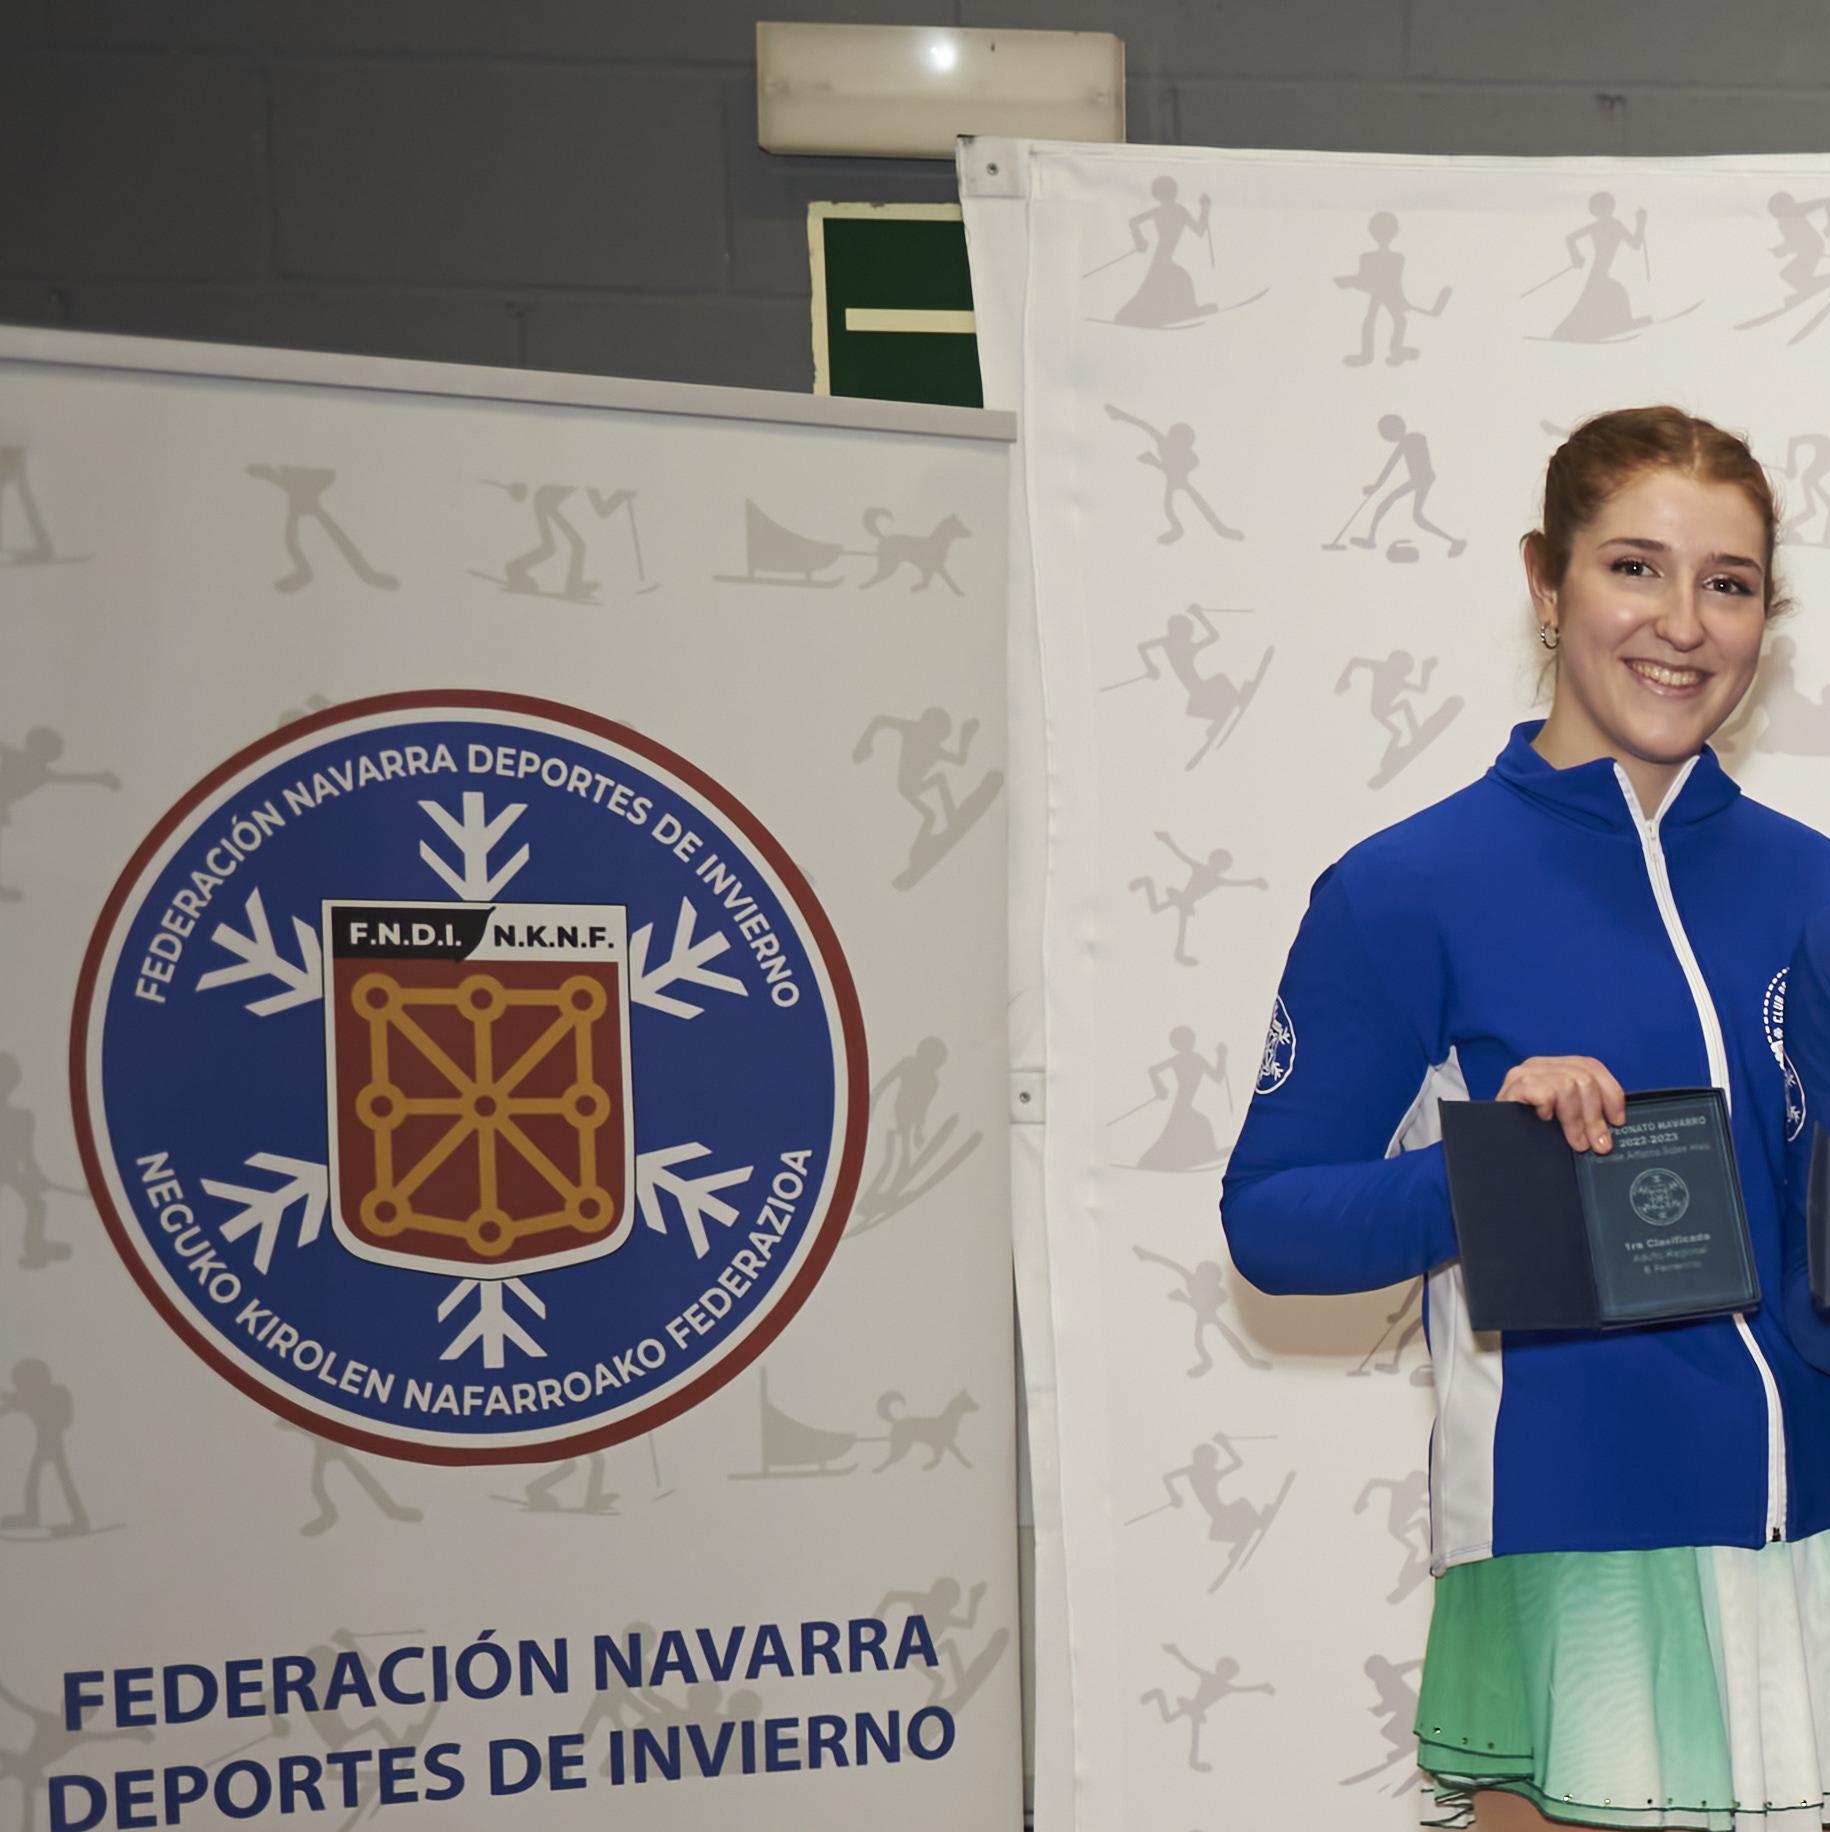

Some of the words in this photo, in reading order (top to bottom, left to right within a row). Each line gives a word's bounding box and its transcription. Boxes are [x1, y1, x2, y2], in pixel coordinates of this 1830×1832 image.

[134, 799, 286, 1005] FEDERACIÓN
[286, 742, 458, 819] NAVARRA
[466, 743, 653, 822] DEPORTES
[650, 809, 705, 866] DE
[695, 852, 802, 1009] INVIERNO
[349, 921, 461, 949] F.N.D.I.
[493, 926, 615, 950] N.K.N.F.
[136, 1151, 241, 1307] NEGUKO
[235, 1298, 395, 1405] KIROLEN
[402, 1337, 666, 1418] NAFARROAKO
[664, 1147, 814, 1355] FEDERAZIOA
[62, 1630, 568, 1732] FEDERACIÓN
[593, 1614, 938, 1689] NAVARRA
[488, 1734, 586, 1795] DE
[610, 1705, 957, 1786] INVIERNO
